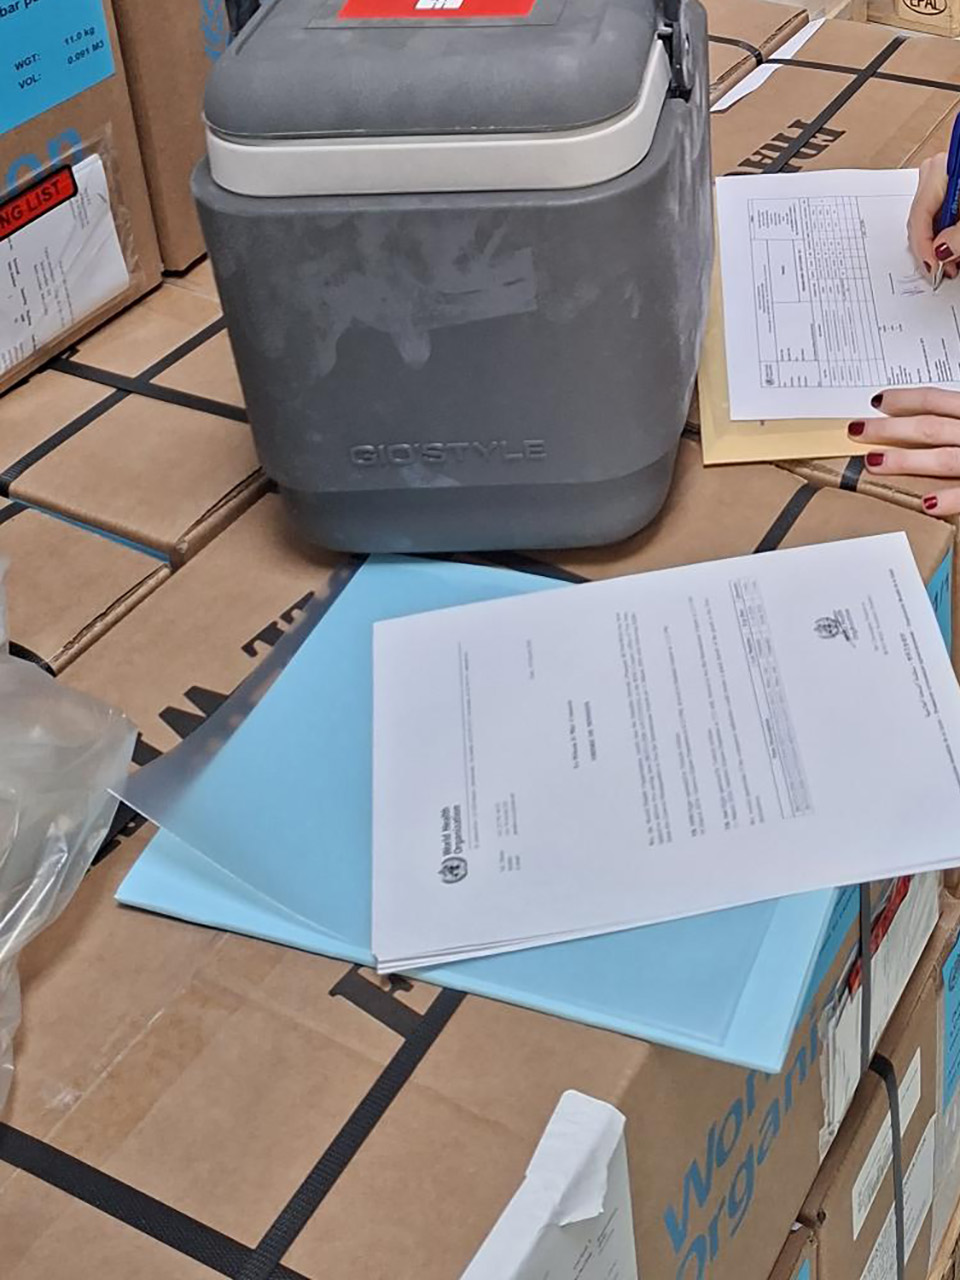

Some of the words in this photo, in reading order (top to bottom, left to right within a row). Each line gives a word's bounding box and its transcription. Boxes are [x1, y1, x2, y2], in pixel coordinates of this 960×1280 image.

[64, 31, 83, 46] 11.0
[84, 26, 96, 39] kg
[14, 53, 42, 71] WGT:
[66, 47, 91, 65] 0.091
[18, 73, 42, 90] VOL:
[25, 178, 63, 214] LIST
[349, 439, 548, 467] GIO'STYLE
[440, 806, 450, 832] Health
[442, 832, 452, 857] World
[664, 1071, 772, 1255] Wor
